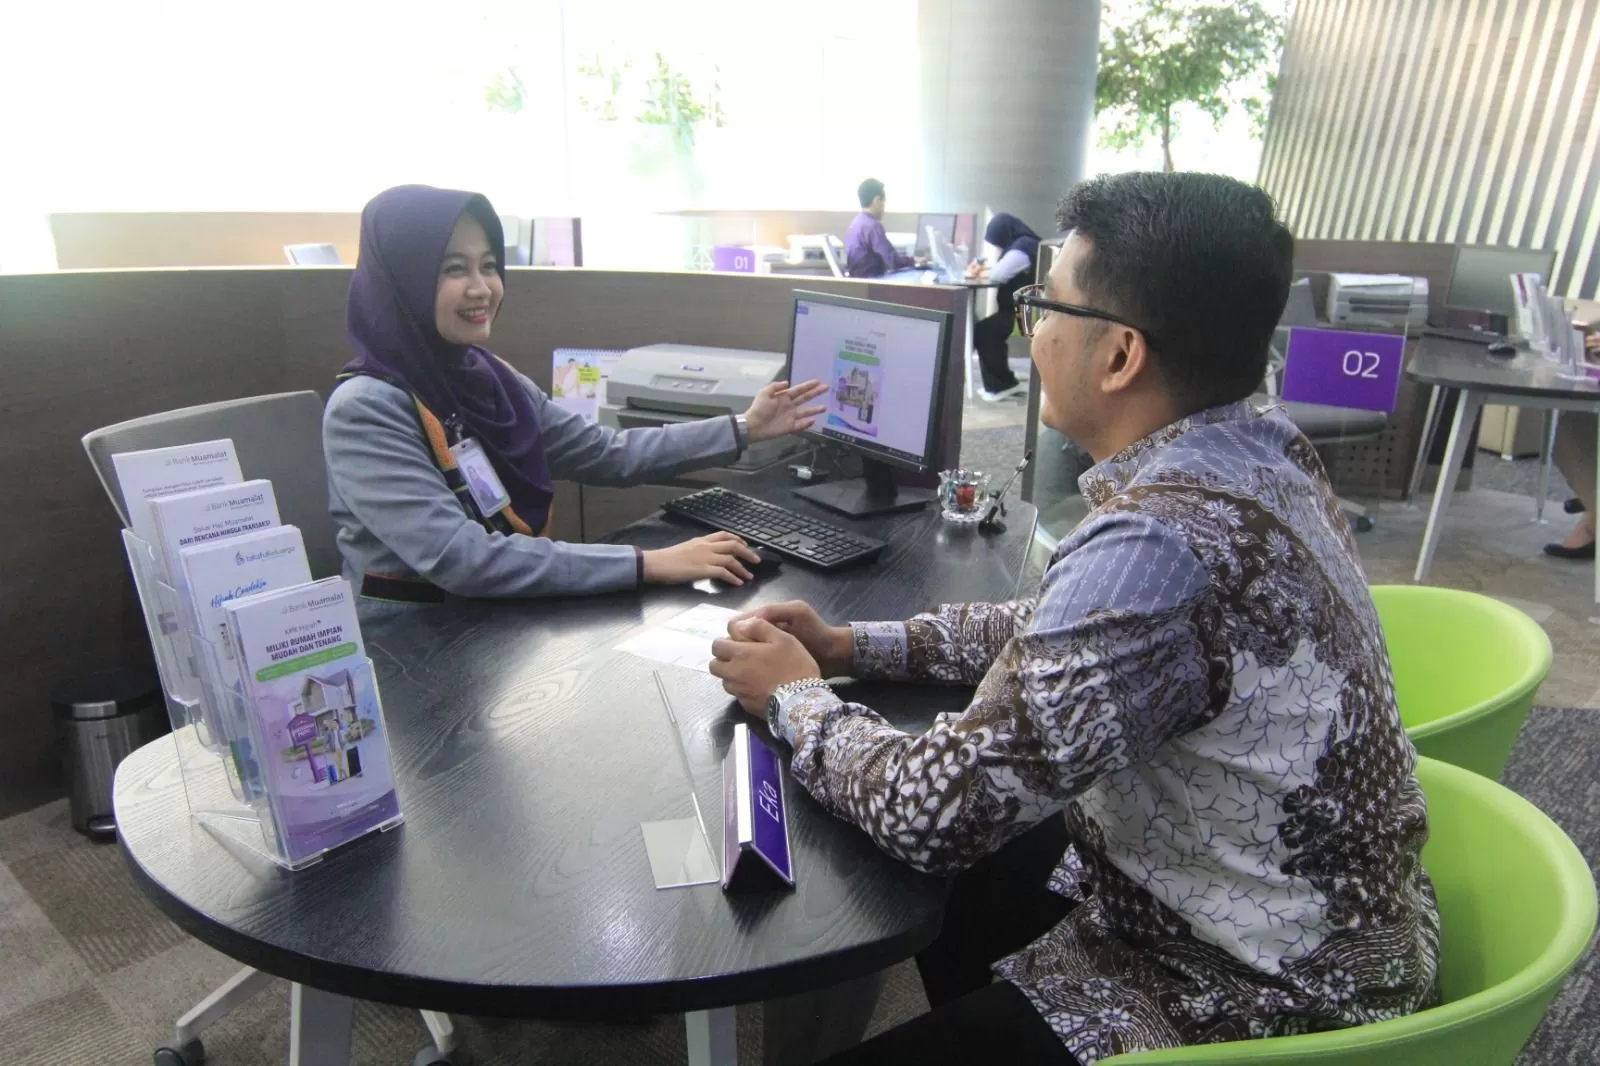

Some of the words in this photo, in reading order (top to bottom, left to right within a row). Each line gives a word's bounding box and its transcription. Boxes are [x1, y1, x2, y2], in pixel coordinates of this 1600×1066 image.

[735, 256, 748, 270] 01
[1343, 350, 1380, 378] 02
[194, 531, 220, 542] RENCANA
[220, 526, 241, 536] HINGGA
[242, 520, 271, 532] TRANSAKSI
[307, 592, 344, 608] Muamalat
[266, 641, 289, 654] MILIKI
[290, 633, 316, 646] RUMAH
[317, 625, 342, 640] IMPIAN
[272, 649, 298, 661] MUDAH
[300, 644, 314, 655] DAN
[315, 637, 342, 650] TENANG
[758, 780, 780, 823] Eka
